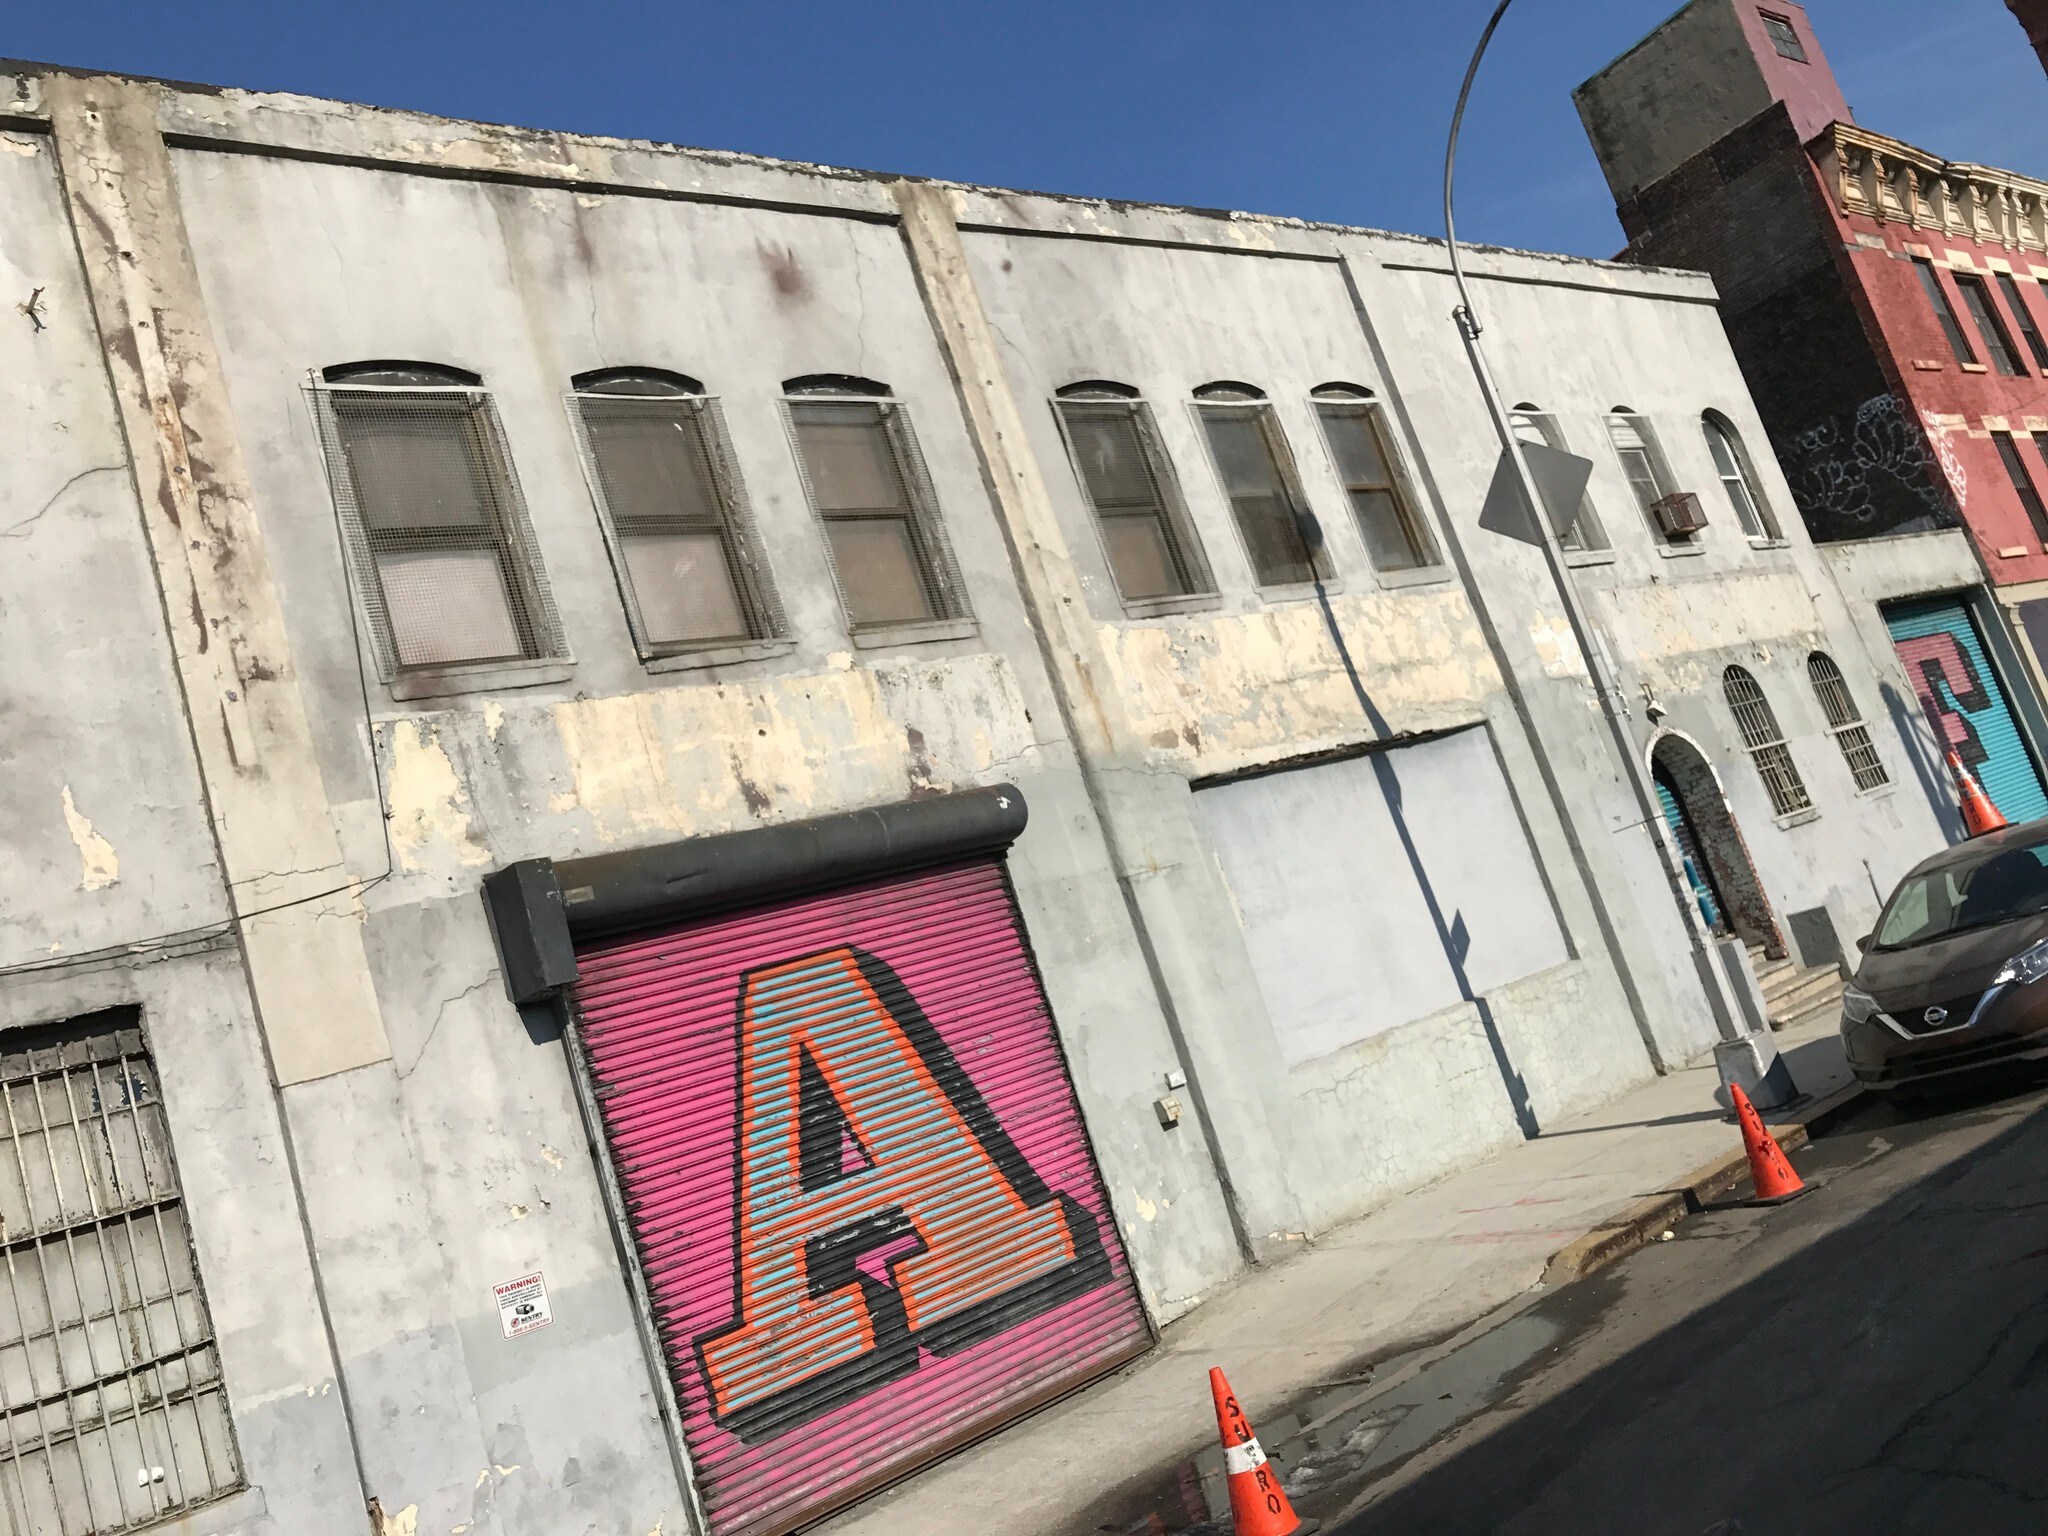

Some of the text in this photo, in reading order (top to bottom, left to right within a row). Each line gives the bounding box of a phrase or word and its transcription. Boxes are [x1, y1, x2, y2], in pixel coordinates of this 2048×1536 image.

[693, 942, 1113, 1444] A
[496, 1275, 541, 1295] WARNING!
[521, 1312, 543, 1322] SENTRY
